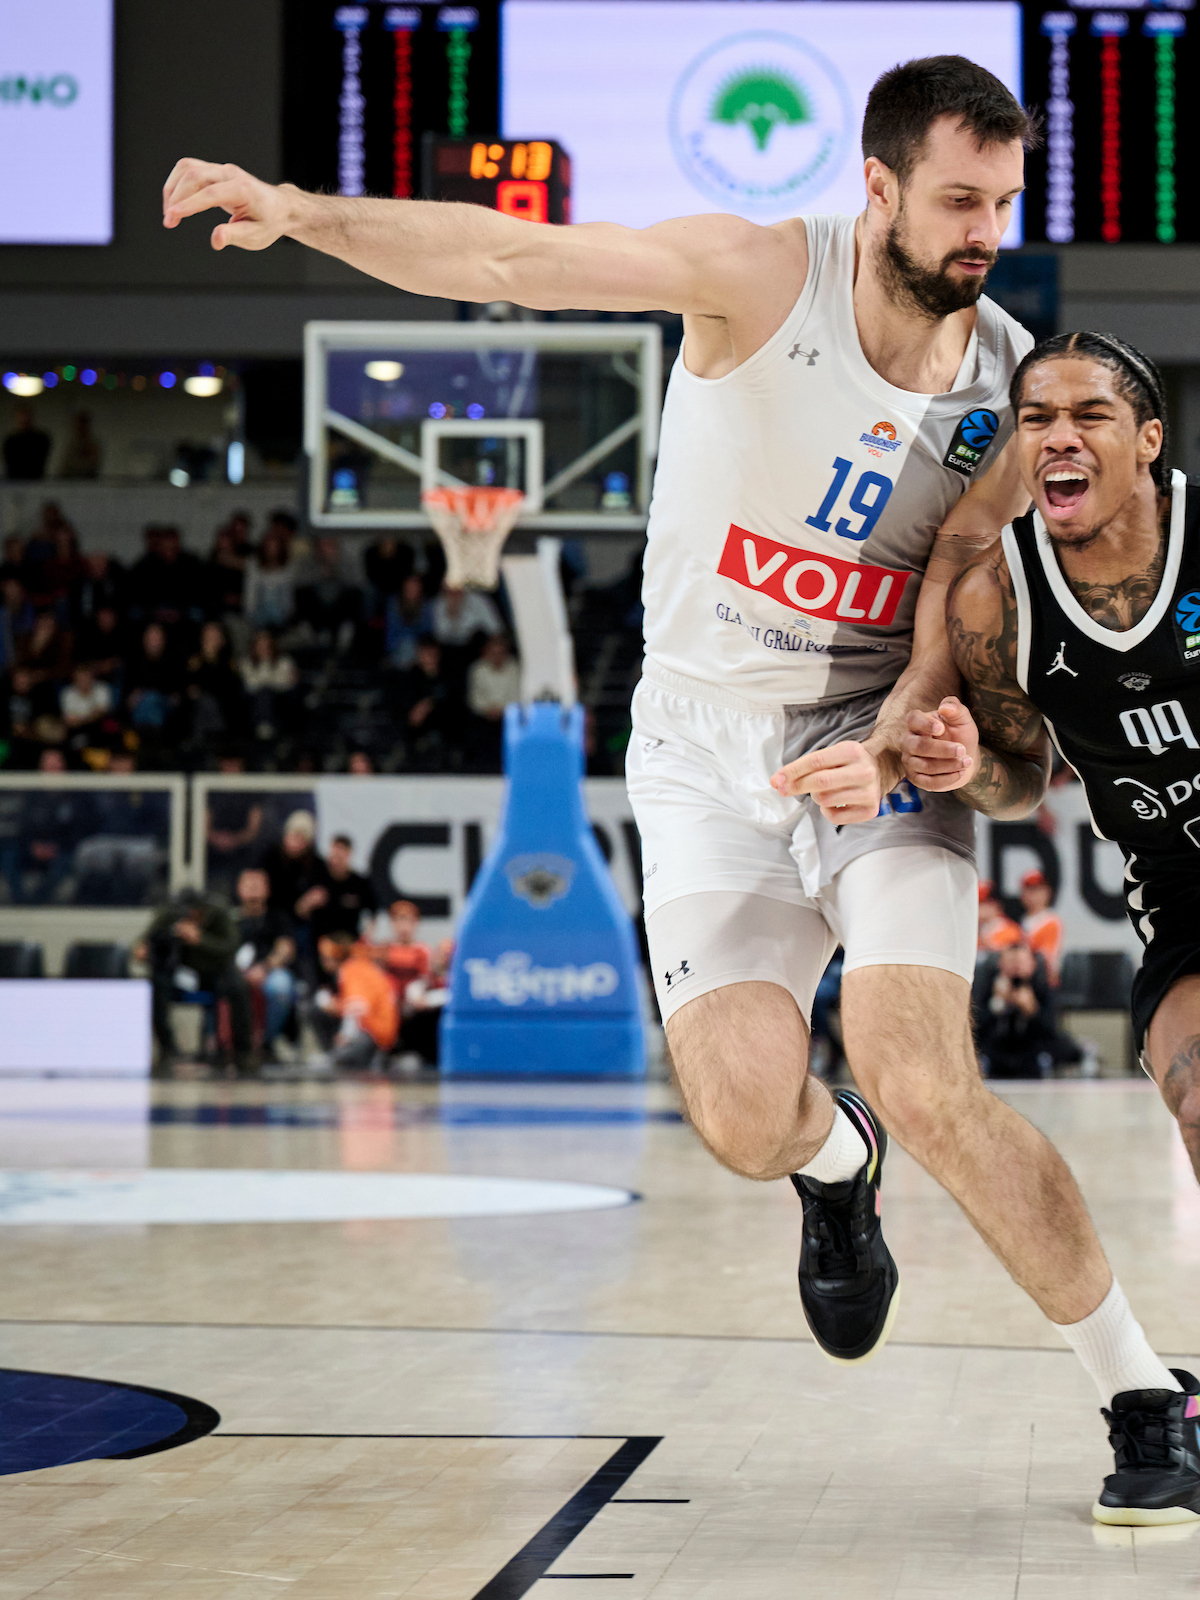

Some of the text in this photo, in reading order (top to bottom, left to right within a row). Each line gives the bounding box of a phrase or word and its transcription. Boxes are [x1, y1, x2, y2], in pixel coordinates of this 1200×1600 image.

[956, 446, 981, 461] BKT
[805, 456, 893, 541] 19
[742, 538, 894, 620] VOLI
[763, 629, 803, 652] GRAD
